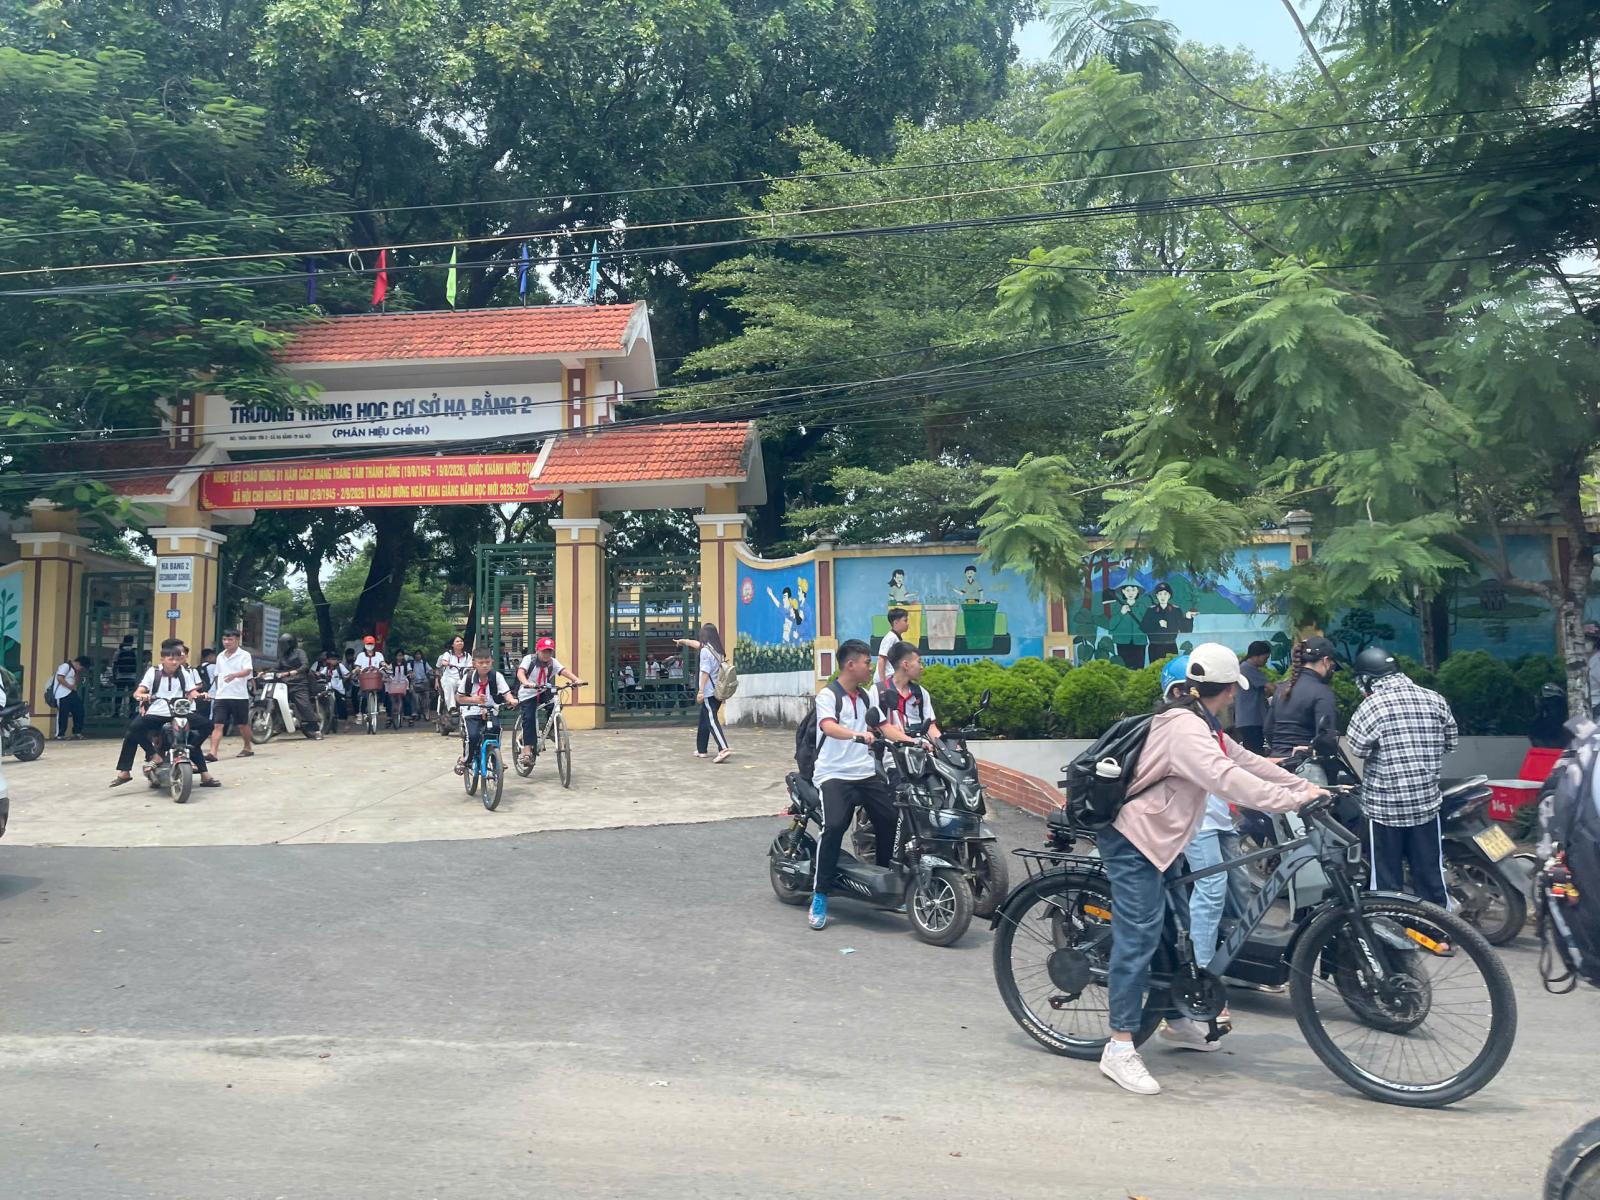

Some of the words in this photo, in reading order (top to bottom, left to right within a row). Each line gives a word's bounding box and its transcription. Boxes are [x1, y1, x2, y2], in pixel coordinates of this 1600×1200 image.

[300, 402, 353, 422] TRUNG
[356, 402, 389, 423] HỌC
[393, 398, 415, 418] CƠ
[418, 392, 441, 418] SỞ
[444, 398, 467, 421] HẠ
[471, 391, 517, 417] BẰNG
[520, 396, 532, 414] 2
[332, 426, 366, 439] (PHÂN
[368, 425, 389, 439] HIỆU
[392, 423, 430, 436] CHÍNH)
[468, 458, 483, 477] QUỐC
[484, 460, 504, 476] KHÁNH
[505, 460, 521, 475] NƯỚC
[376, 483, 392, 499] CHÀO
[392, 482, 410, 498] MỪNG
[410, 482, 426, 498] NGÀY
[426, 485, 441, 498] KHAI
[460, 481, 474, 497] NĂM
[474, 483, 487, 499] HỌC
[487, 481, 499, 496] MỚI
[185, 562, 190, 570] 2
[1225, 870, 1286, 957] CALIFA
